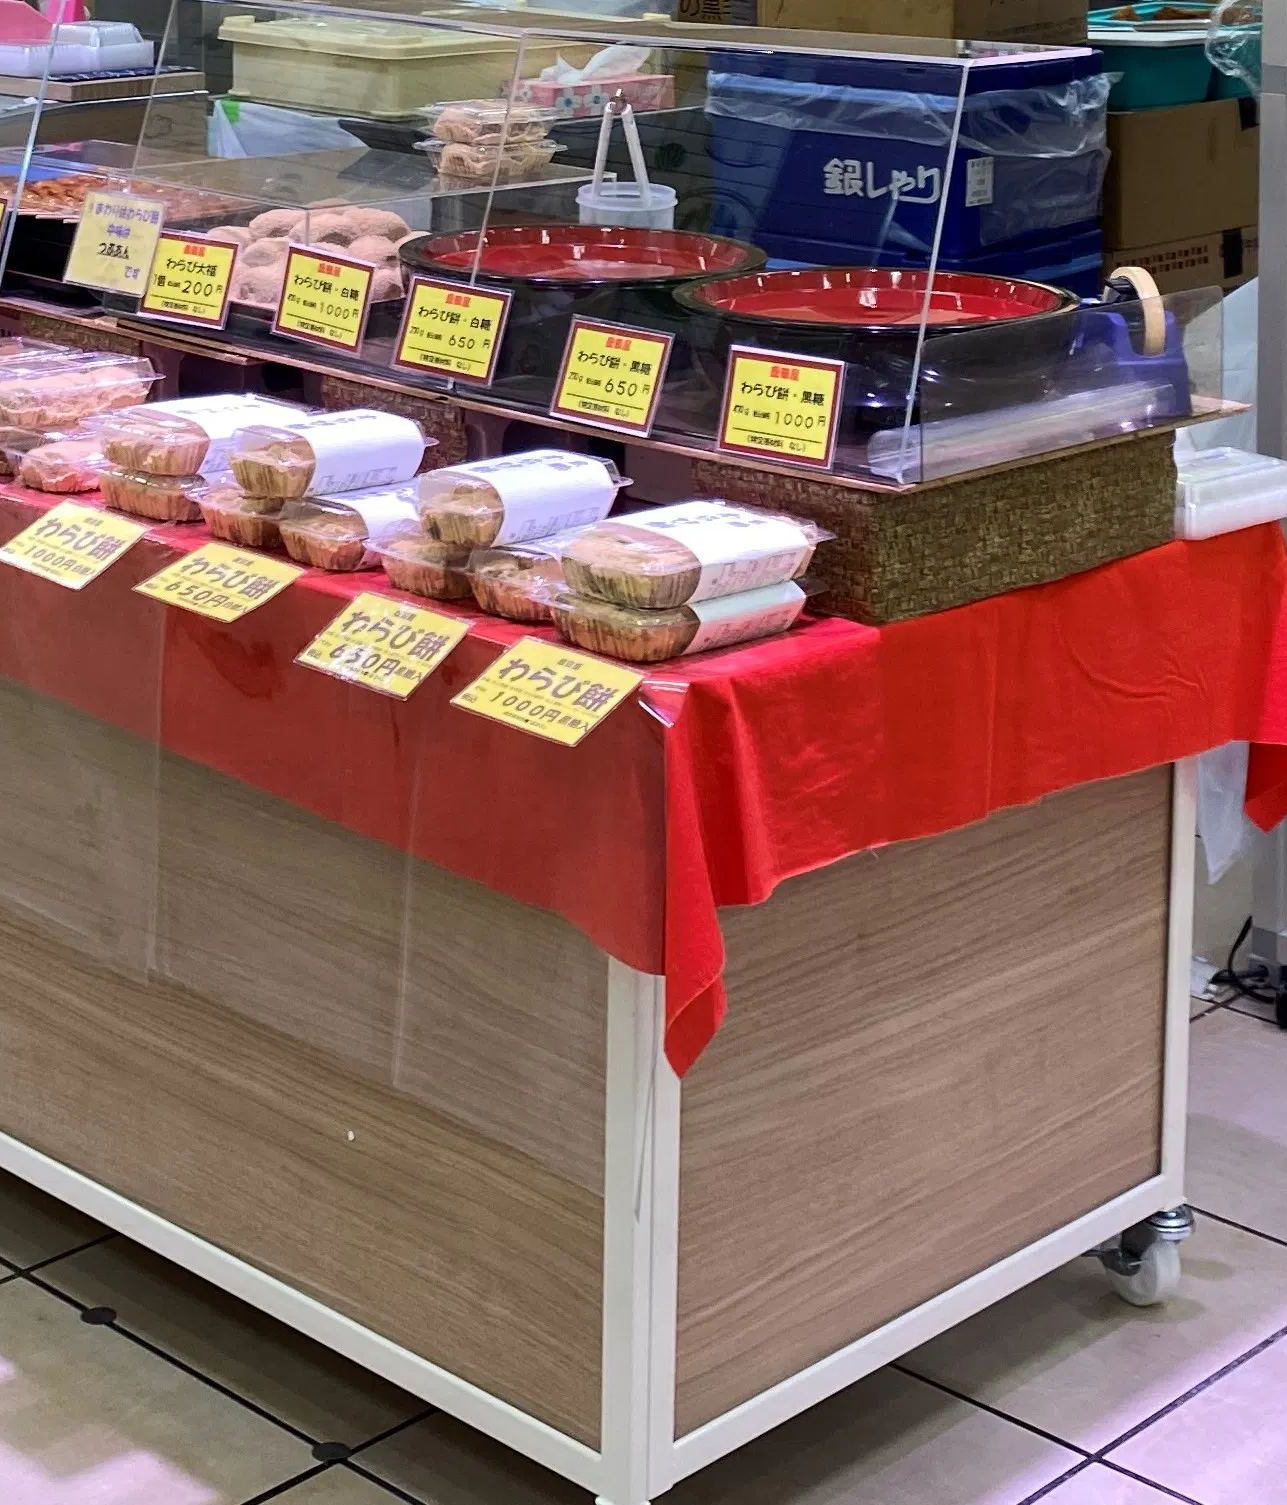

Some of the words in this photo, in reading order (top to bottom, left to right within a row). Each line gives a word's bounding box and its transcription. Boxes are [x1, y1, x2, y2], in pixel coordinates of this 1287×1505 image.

[823, 157, 941, 204] 銀しゃり
[166, 258, 218, 277] わらび大福
[35, 517, 127, 561] わらび餅
[179, 556, 281, 600] わらび餅
[341, 611, 450, 662] わらび餅
[498, 658, 619, 713] わらび餅
